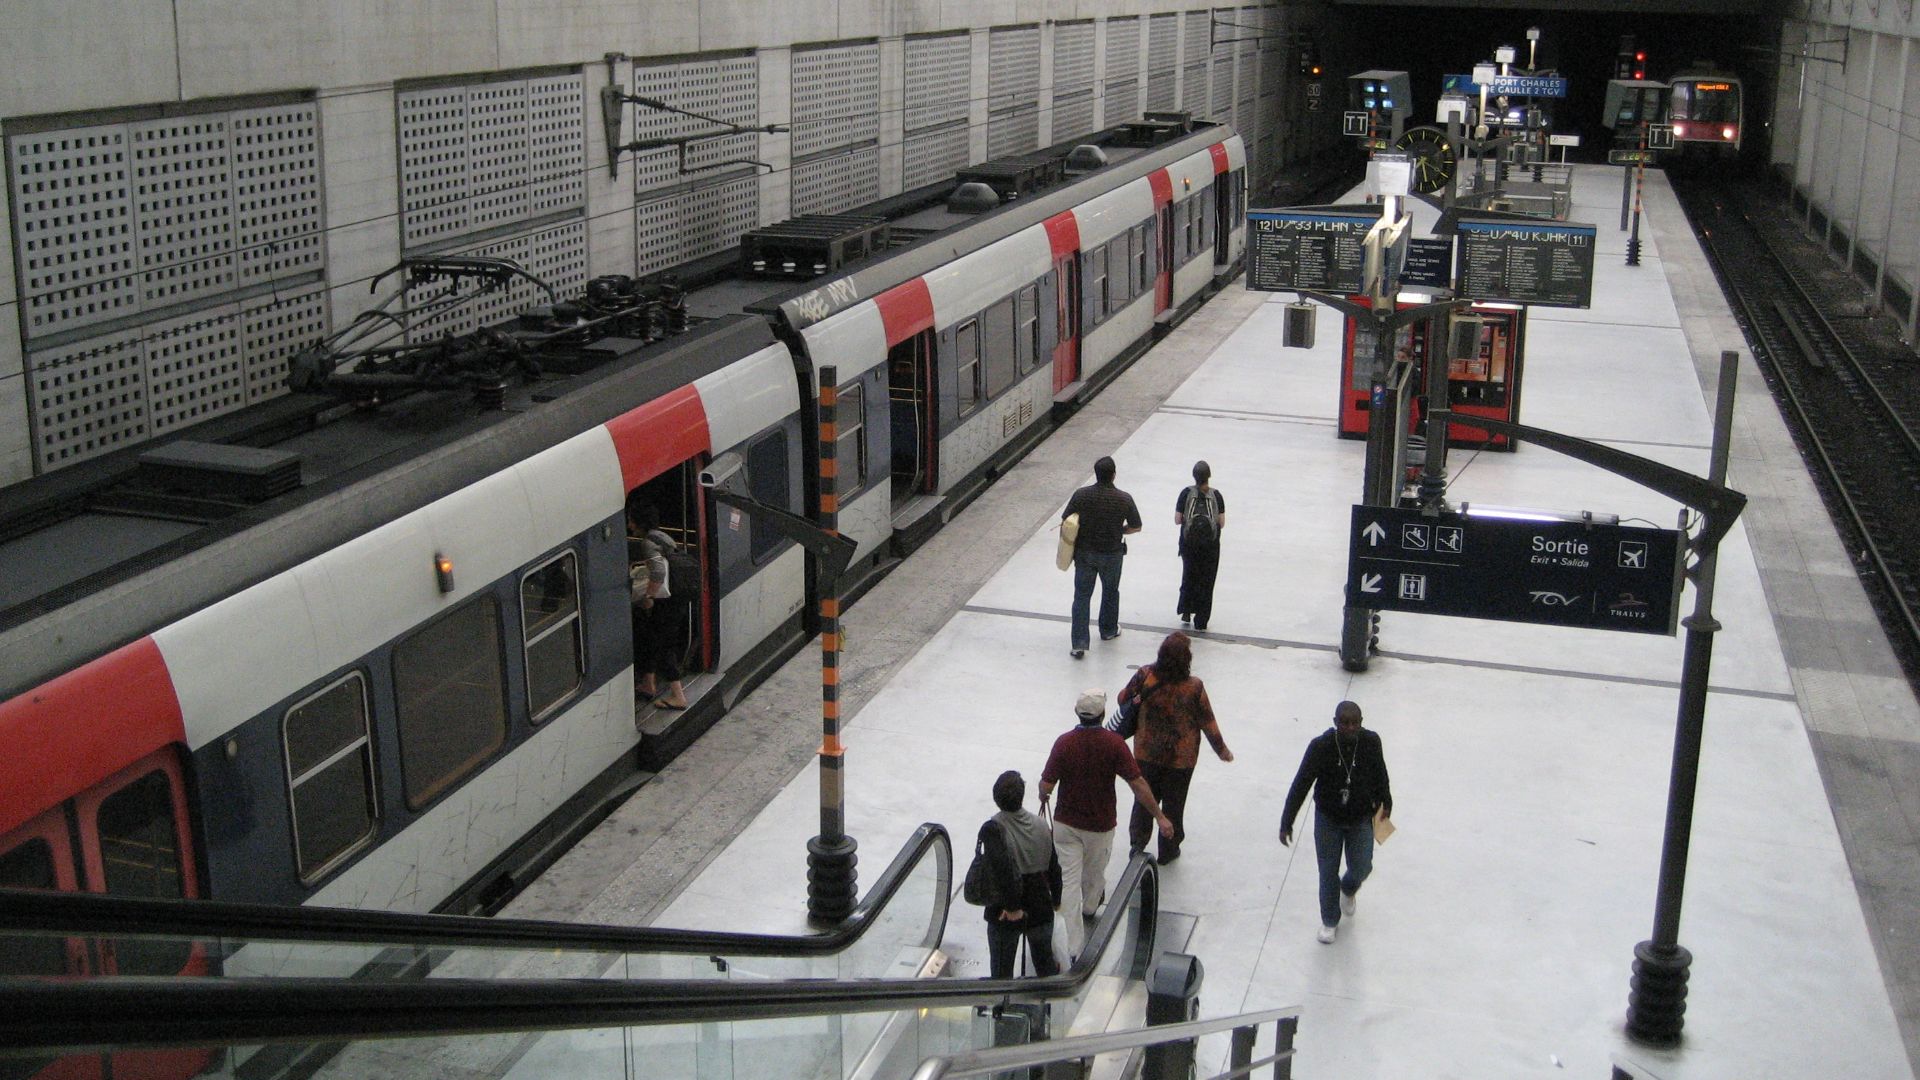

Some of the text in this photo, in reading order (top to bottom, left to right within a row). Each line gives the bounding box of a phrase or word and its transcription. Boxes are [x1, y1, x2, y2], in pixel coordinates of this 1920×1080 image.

[1498, 86, 1531, 94] GAULLE
[1260, 221, 1271, 230] 12
[1573, 236, 1583, 245] 11
[1532, 535, 1589, 555] Sortie
[1530, 555, 1589, 568] Exit Salida
[1529, 591, 1580, 606] TGV
[1610, 609, 1646, 618] THALYS
